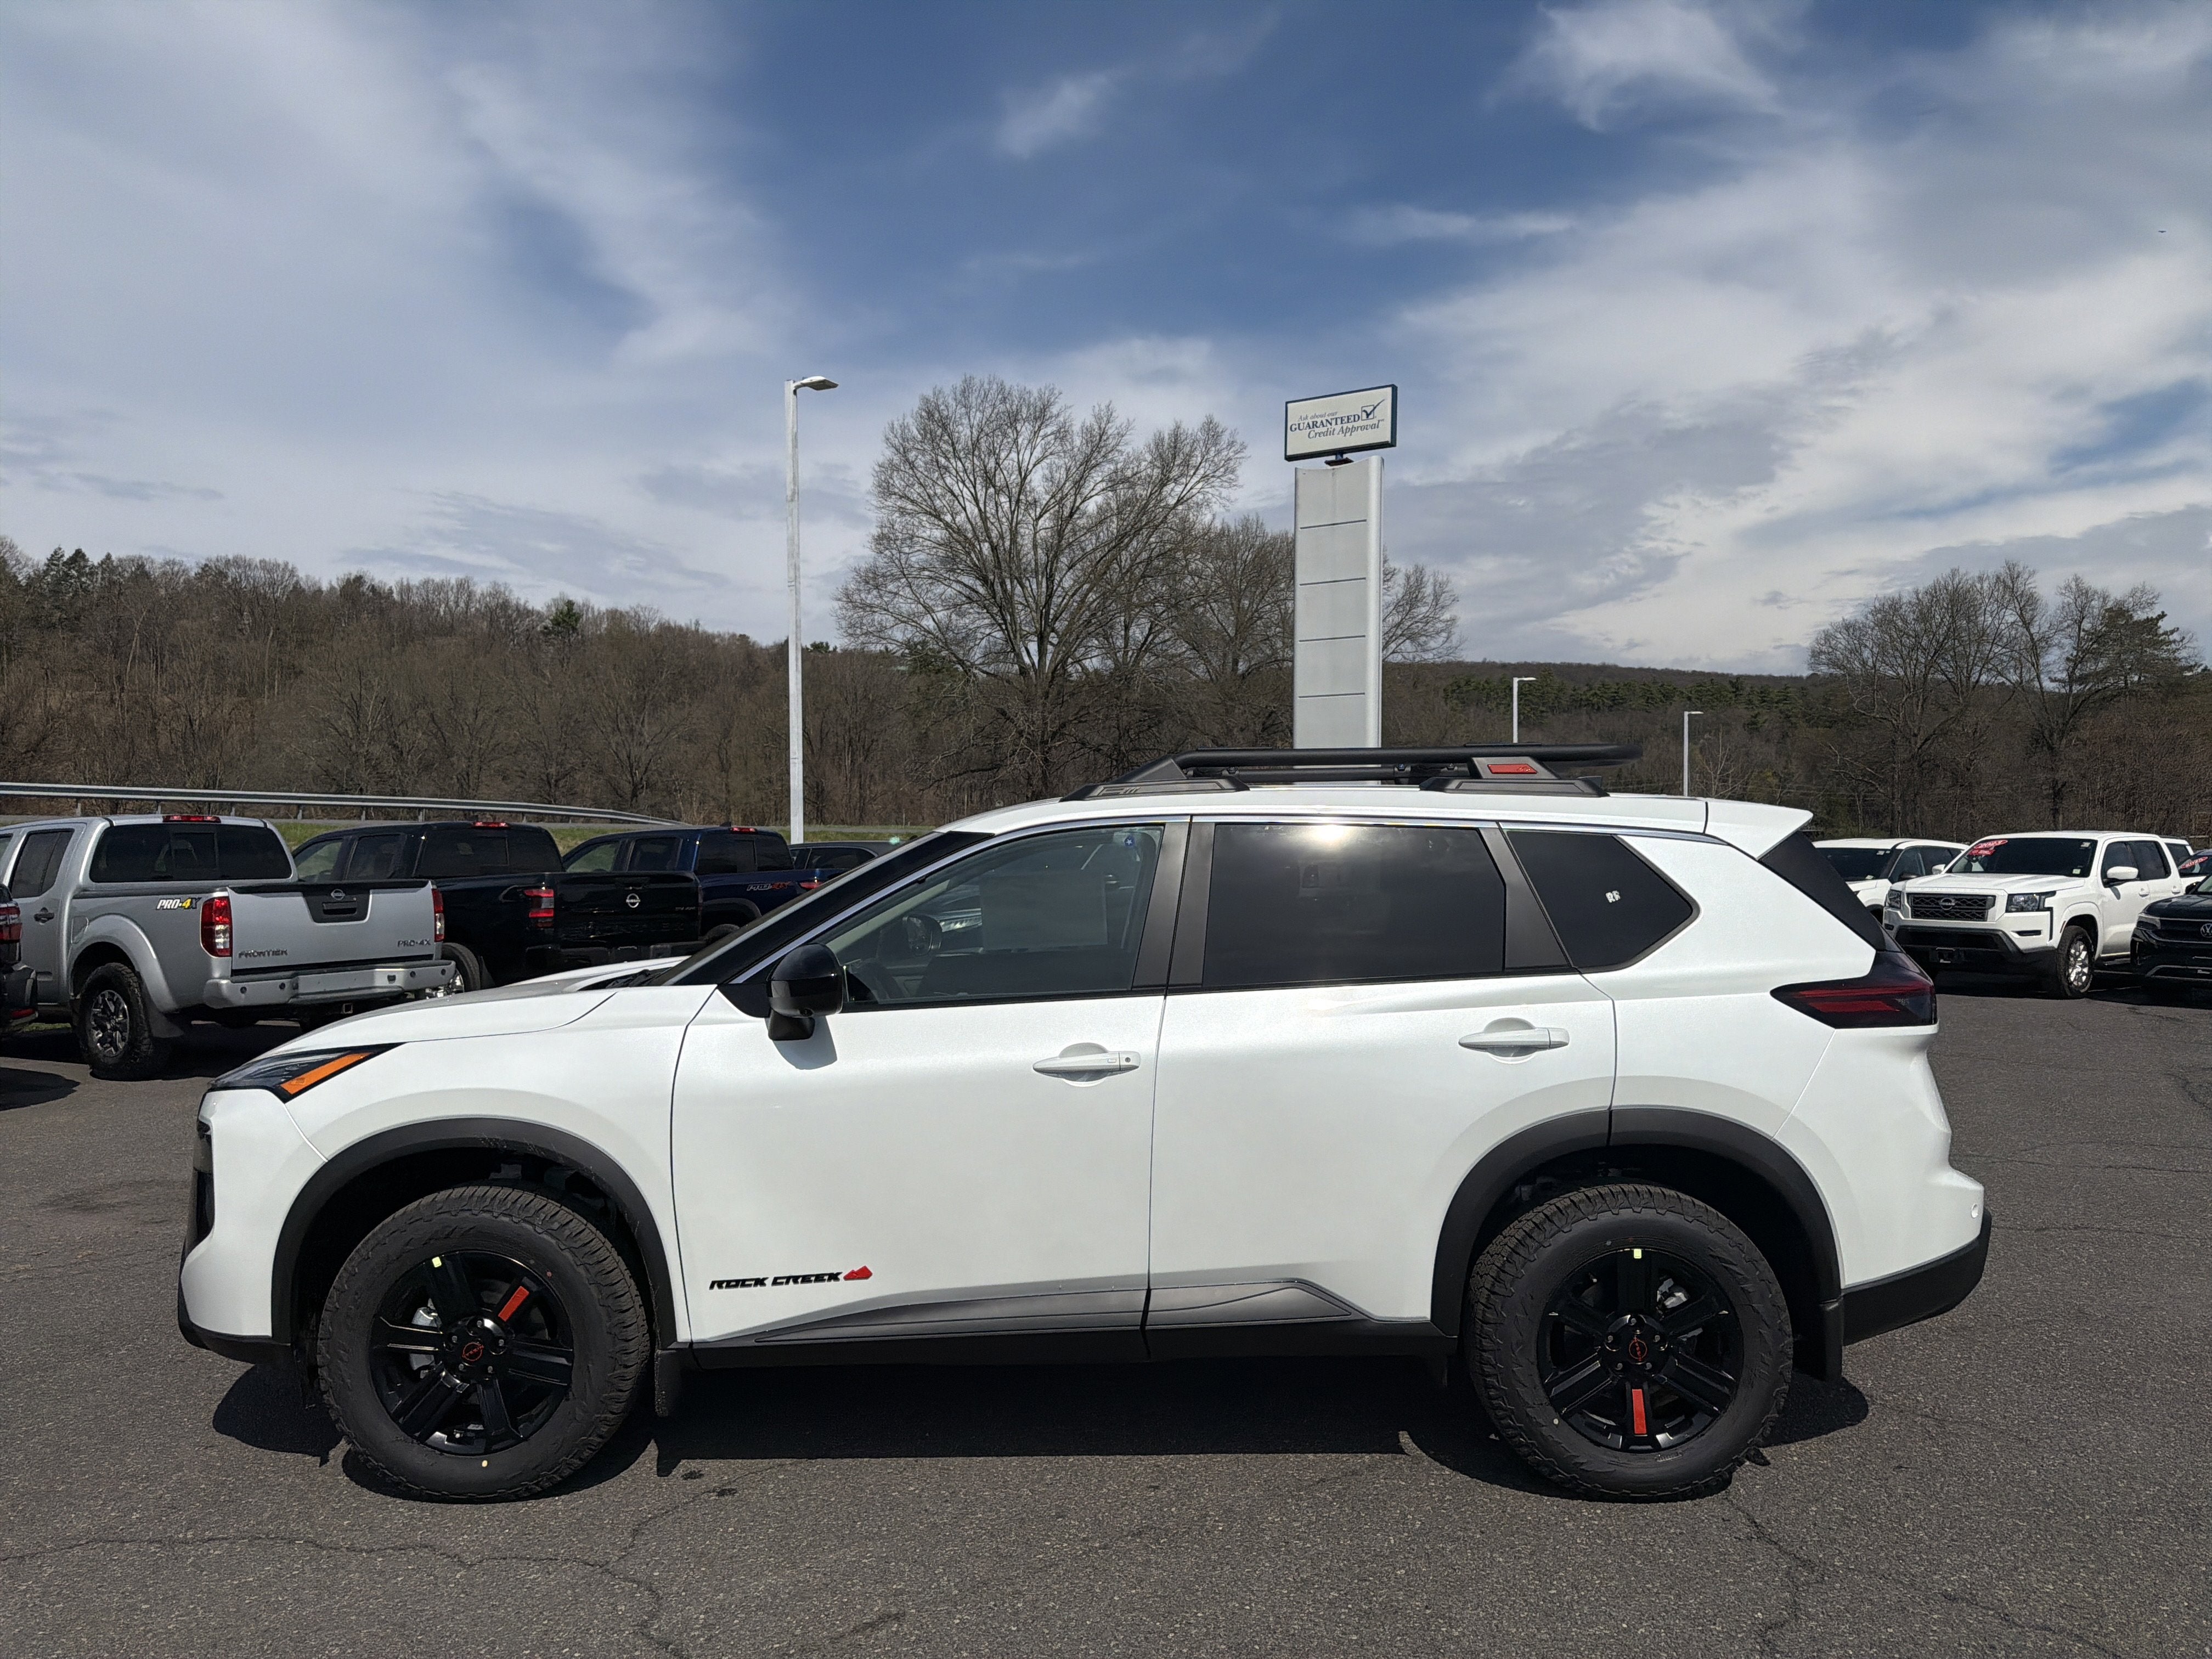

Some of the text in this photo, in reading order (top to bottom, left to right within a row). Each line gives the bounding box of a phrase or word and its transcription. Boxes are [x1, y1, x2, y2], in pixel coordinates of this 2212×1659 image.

[1290, 414, 1360, 432] GUARANTEED
[1310, 412, 1326, 421] about
[1307, 420, 1380, 439] Credit Approval
[156, 896, 202, 910] PRO-4X
[398, 939, 431, 947] PRO-4X
[238, 949, 287, 958] FRONTIER
[709, 1271, 843, 1290] ROCK CREEK
